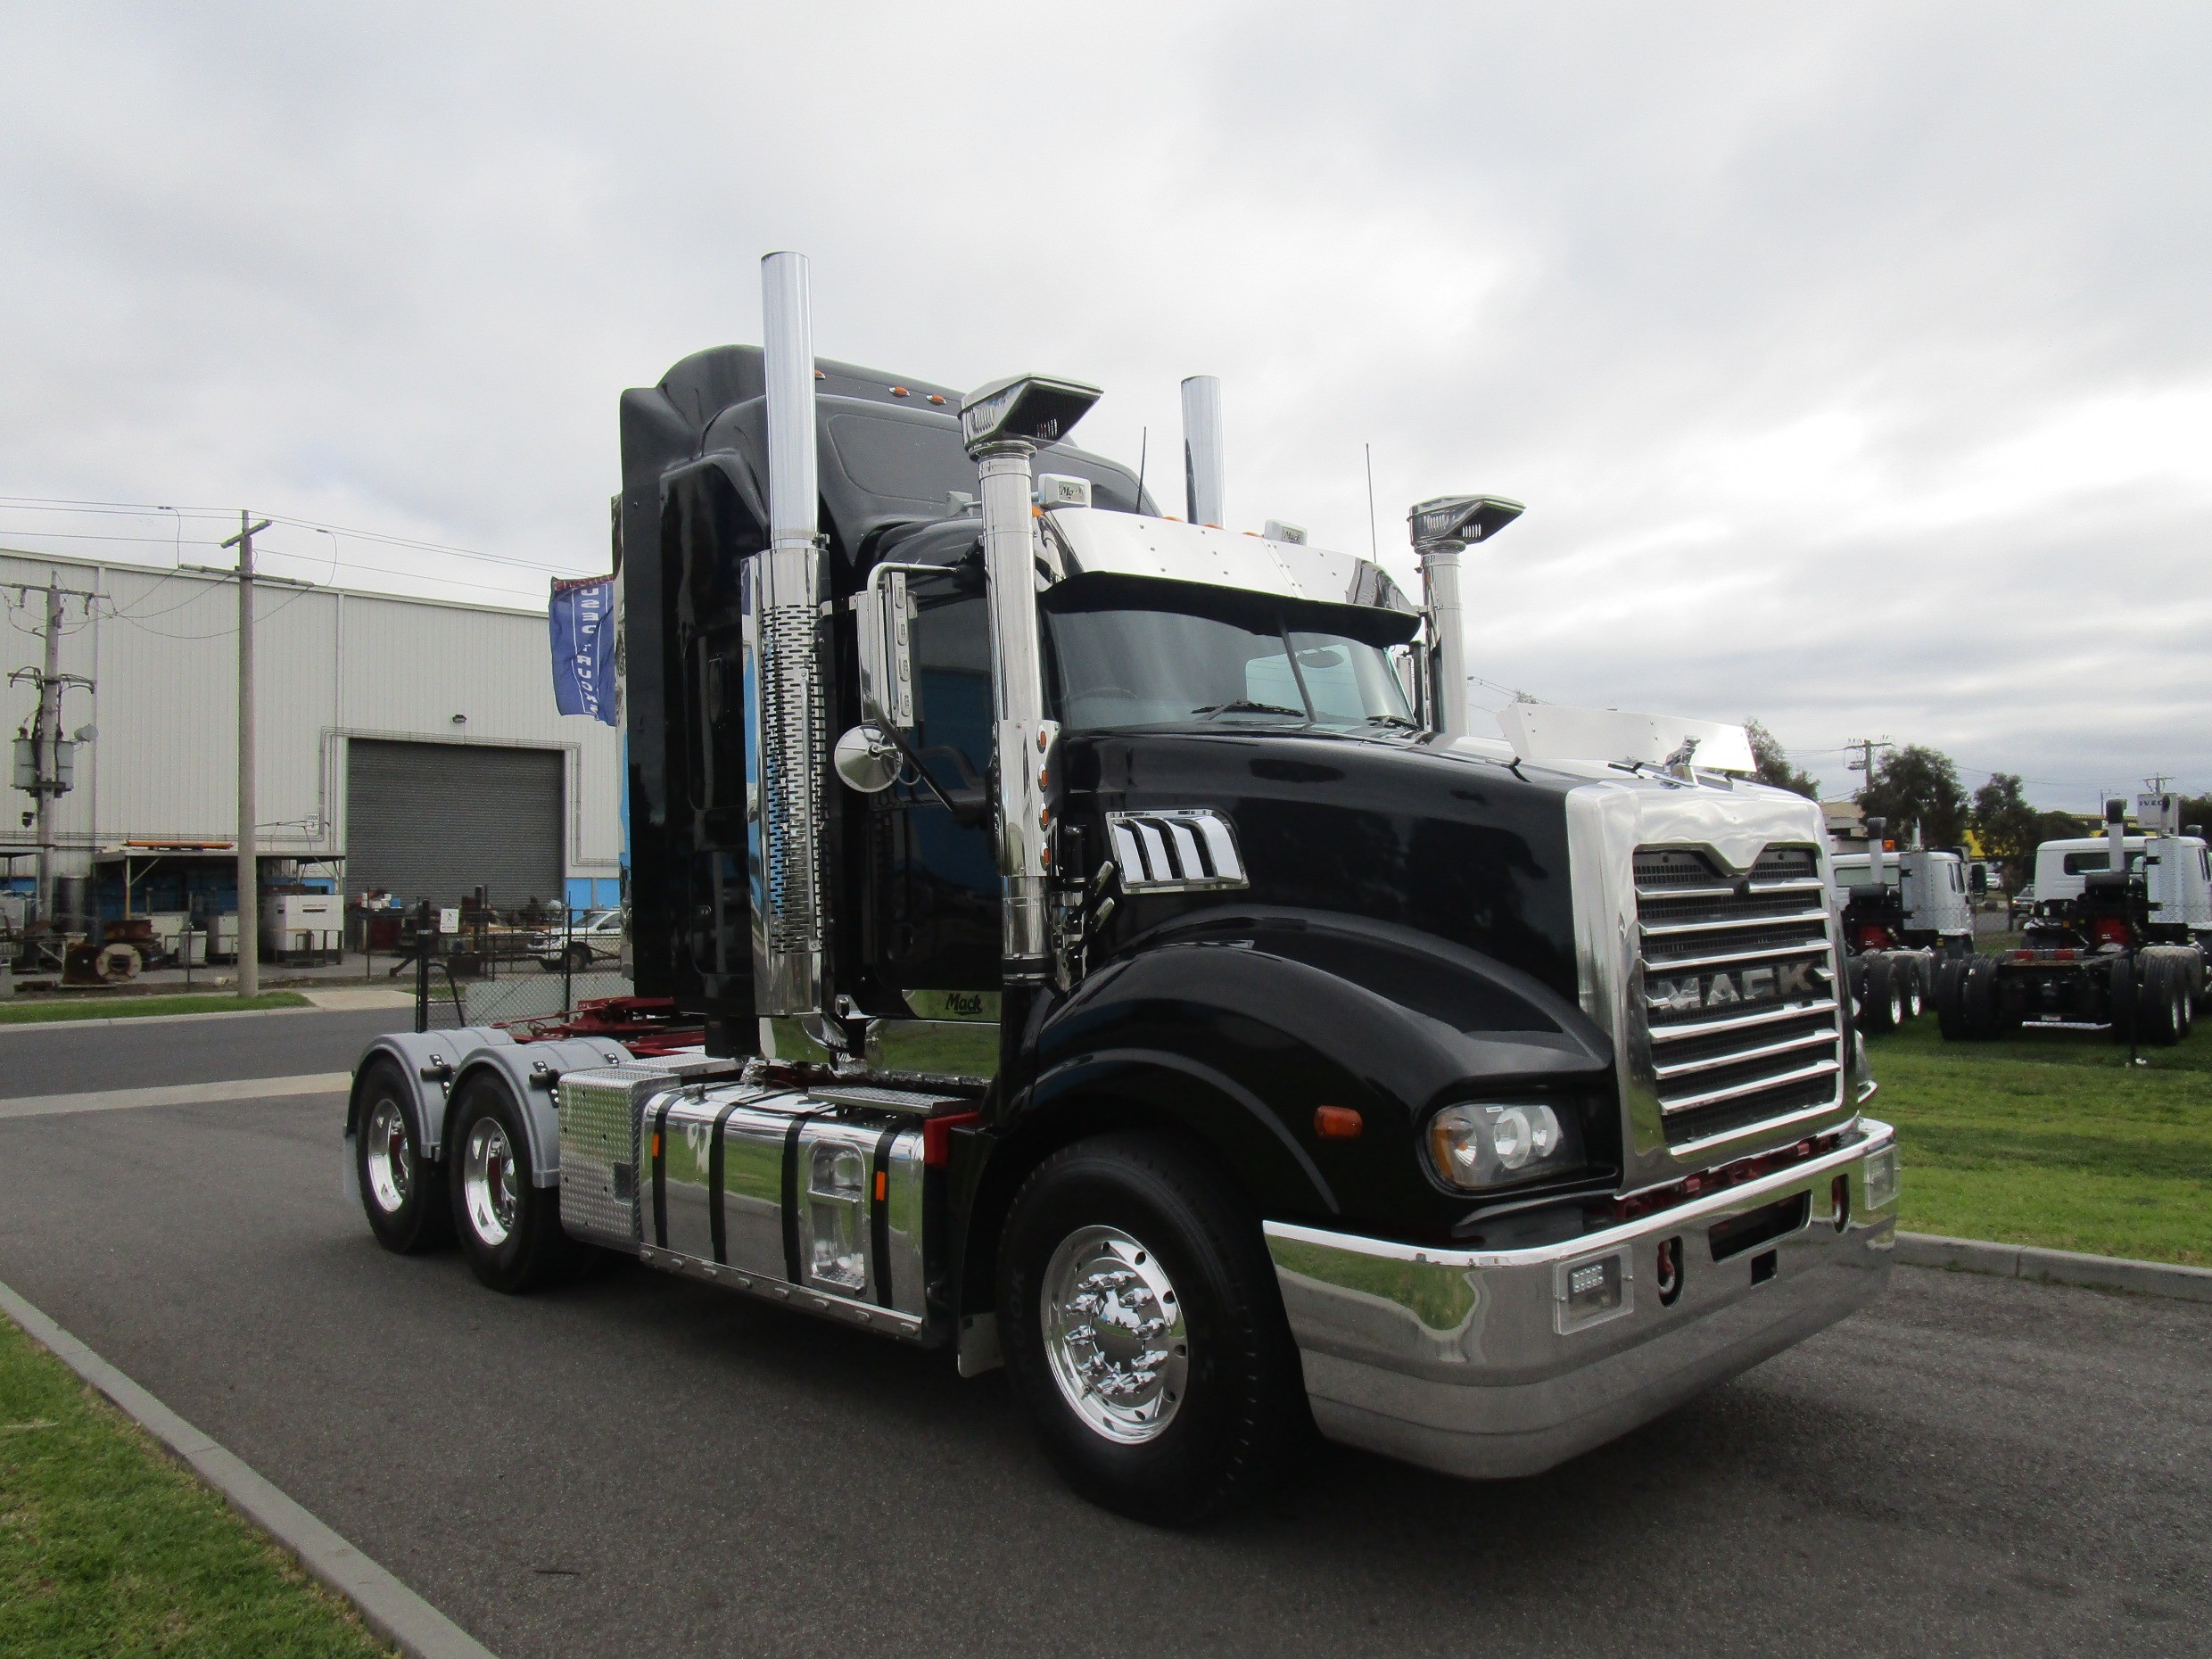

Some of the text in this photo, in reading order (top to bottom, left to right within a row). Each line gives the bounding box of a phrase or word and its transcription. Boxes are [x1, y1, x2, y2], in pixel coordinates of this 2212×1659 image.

[2139, 799, 2163, 807] IVEC
[1656, 960, 1814, 1012] MACK
[945, 993, 983, 1016] Mack
